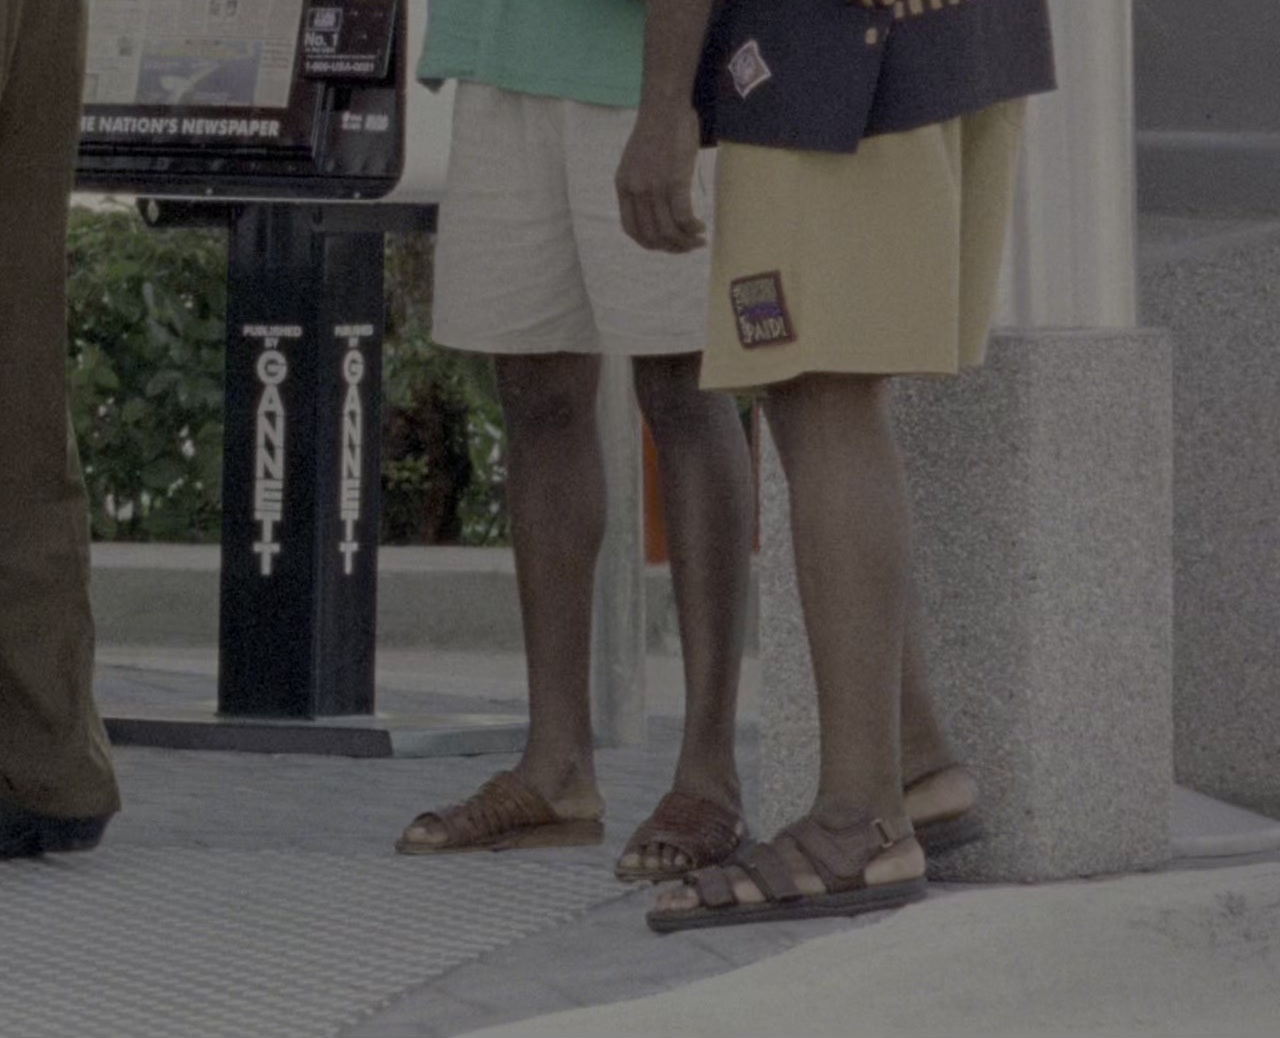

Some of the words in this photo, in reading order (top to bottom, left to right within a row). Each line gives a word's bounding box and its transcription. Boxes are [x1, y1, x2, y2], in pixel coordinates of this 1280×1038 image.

[304, 31, 327, 48] No.
[331, 32, 339, 48] 1
[99, 116, 179, 135] NATION'S
[182, 118, 280, 137] NEWSPAPER
[243, 323, 303, 338] PUBLISHED
[265, 337, 279, 350] BY
[253, 349, 288, 576] GANNETT
[339, 349, 365, 576] GANNETT
